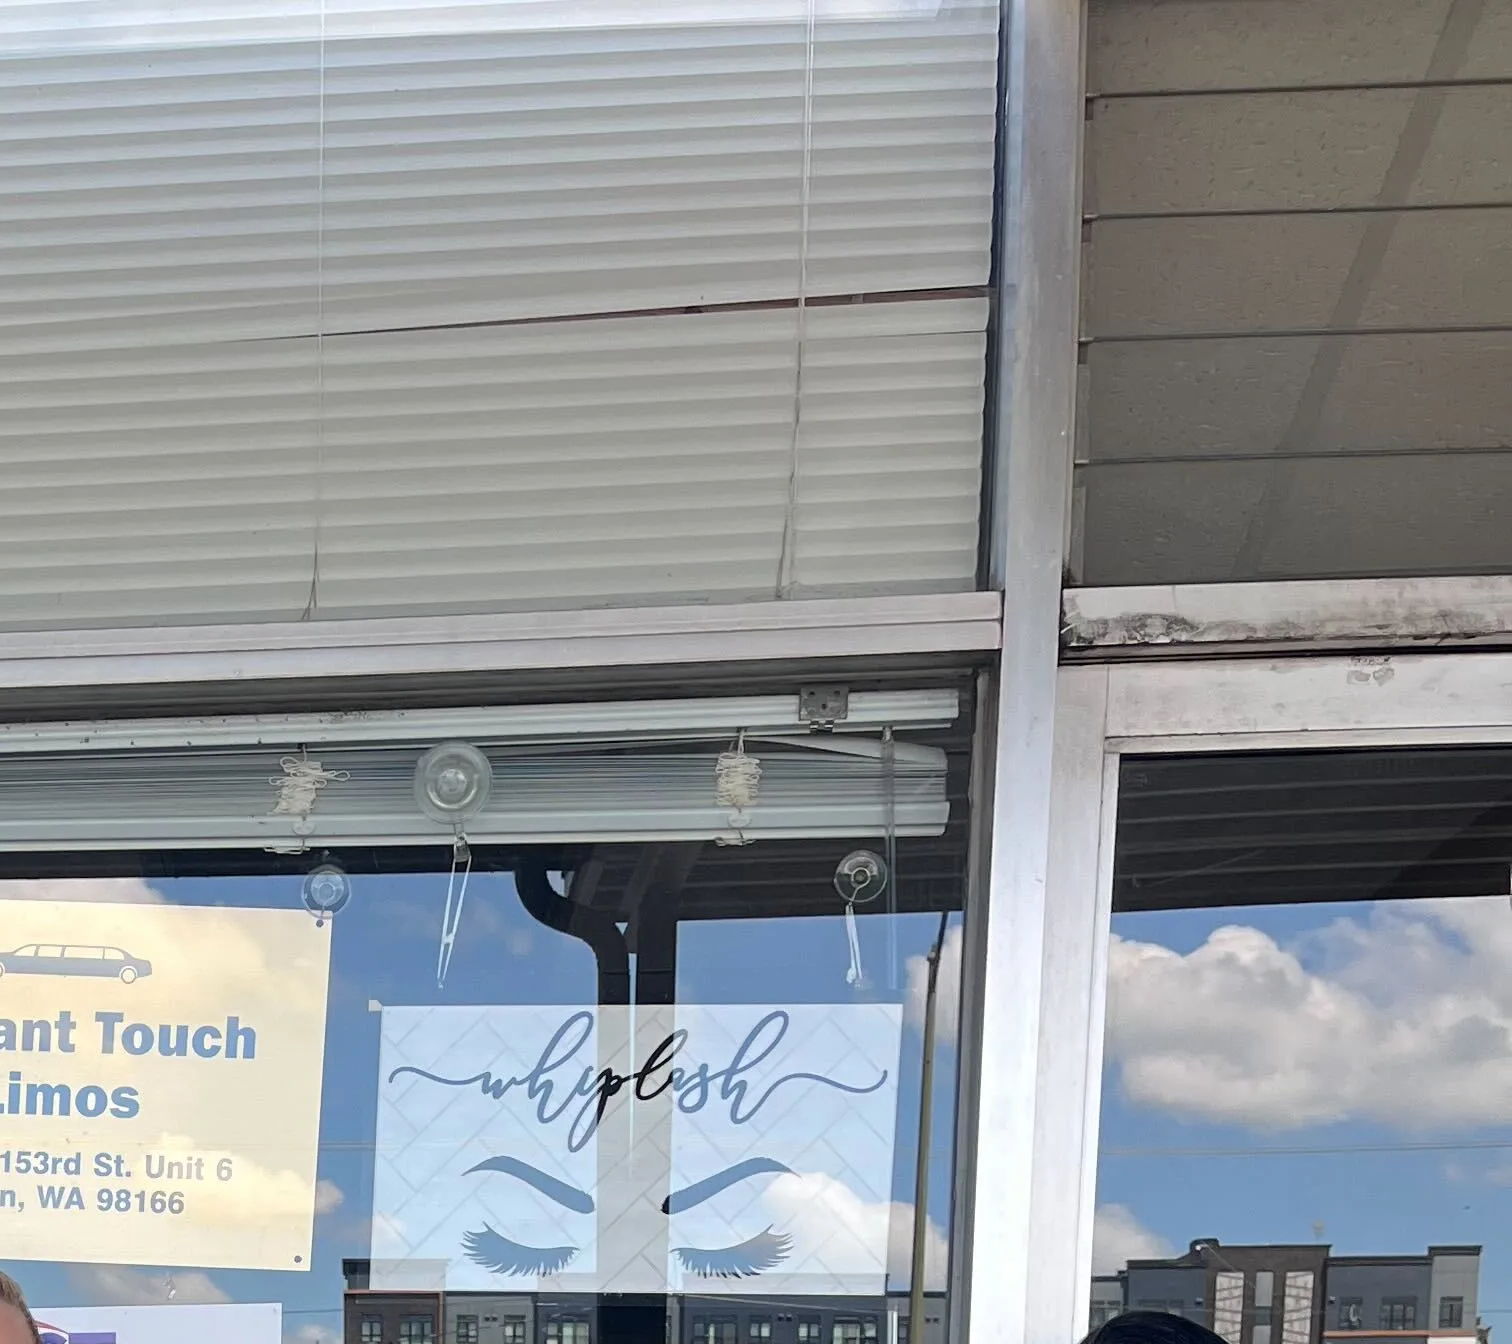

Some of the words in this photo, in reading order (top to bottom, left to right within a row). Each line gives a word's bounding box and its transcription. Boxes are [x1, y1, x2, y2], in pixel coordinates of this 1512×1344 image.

[94, 1011, 257, 1059] Touch
[0, 1150, 81, 1175] 153rd
[94, 1151, 132, 1177] St.
[145, 1154, 204, 1180] Unit
[216, 1157, 233, 1181] 6
[38, 1185, 85, 1210] WA
[97, 1188, 185, 1214] 98166
